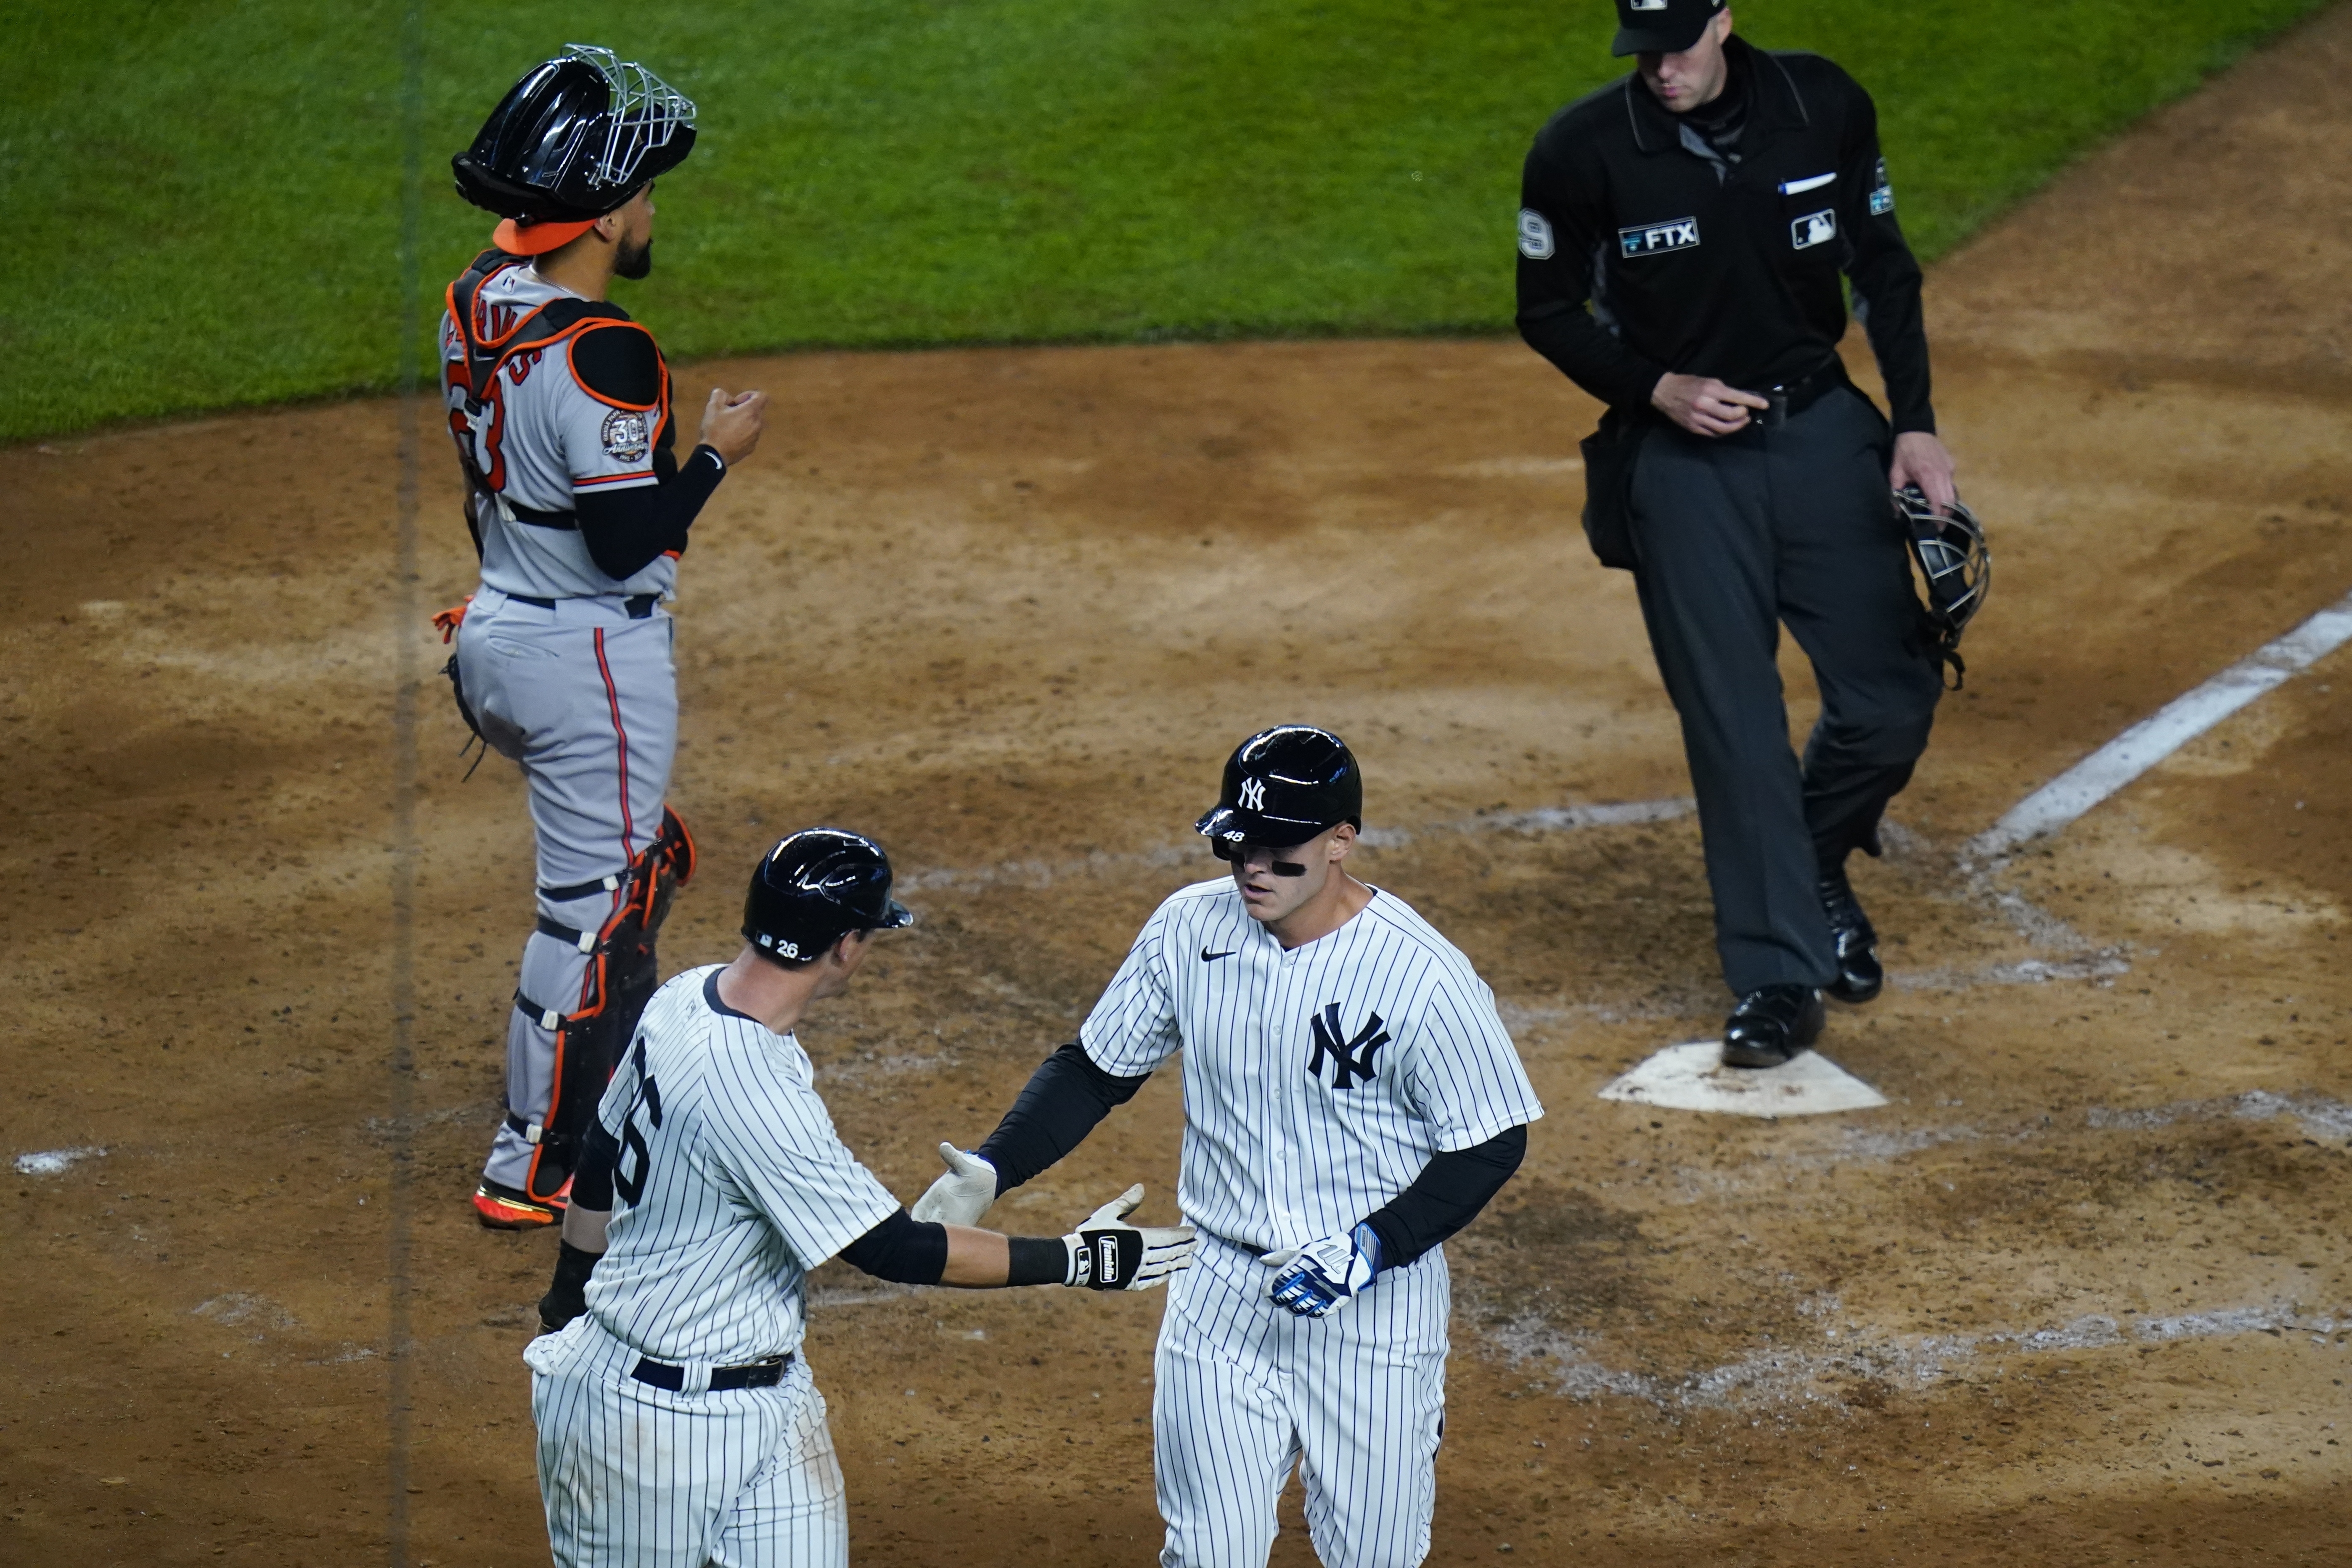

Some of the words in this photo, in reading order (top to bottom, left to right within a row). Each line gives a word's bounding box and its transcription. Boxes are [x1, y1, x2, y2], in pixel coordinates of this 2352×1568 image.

[1519, 209, 1555, 259] 9
[1645, 222, 1695, 250] FTX
[614, 418, 639, 443] 30
[1238, 777, 1266, 812] NY
[1223, 830, 1245, 842] 48
[777, 939, 798, 959] 26
[1307, 1002, 1392, 1089] NY
[1100, 1240, 1115, 1280] Franklin
